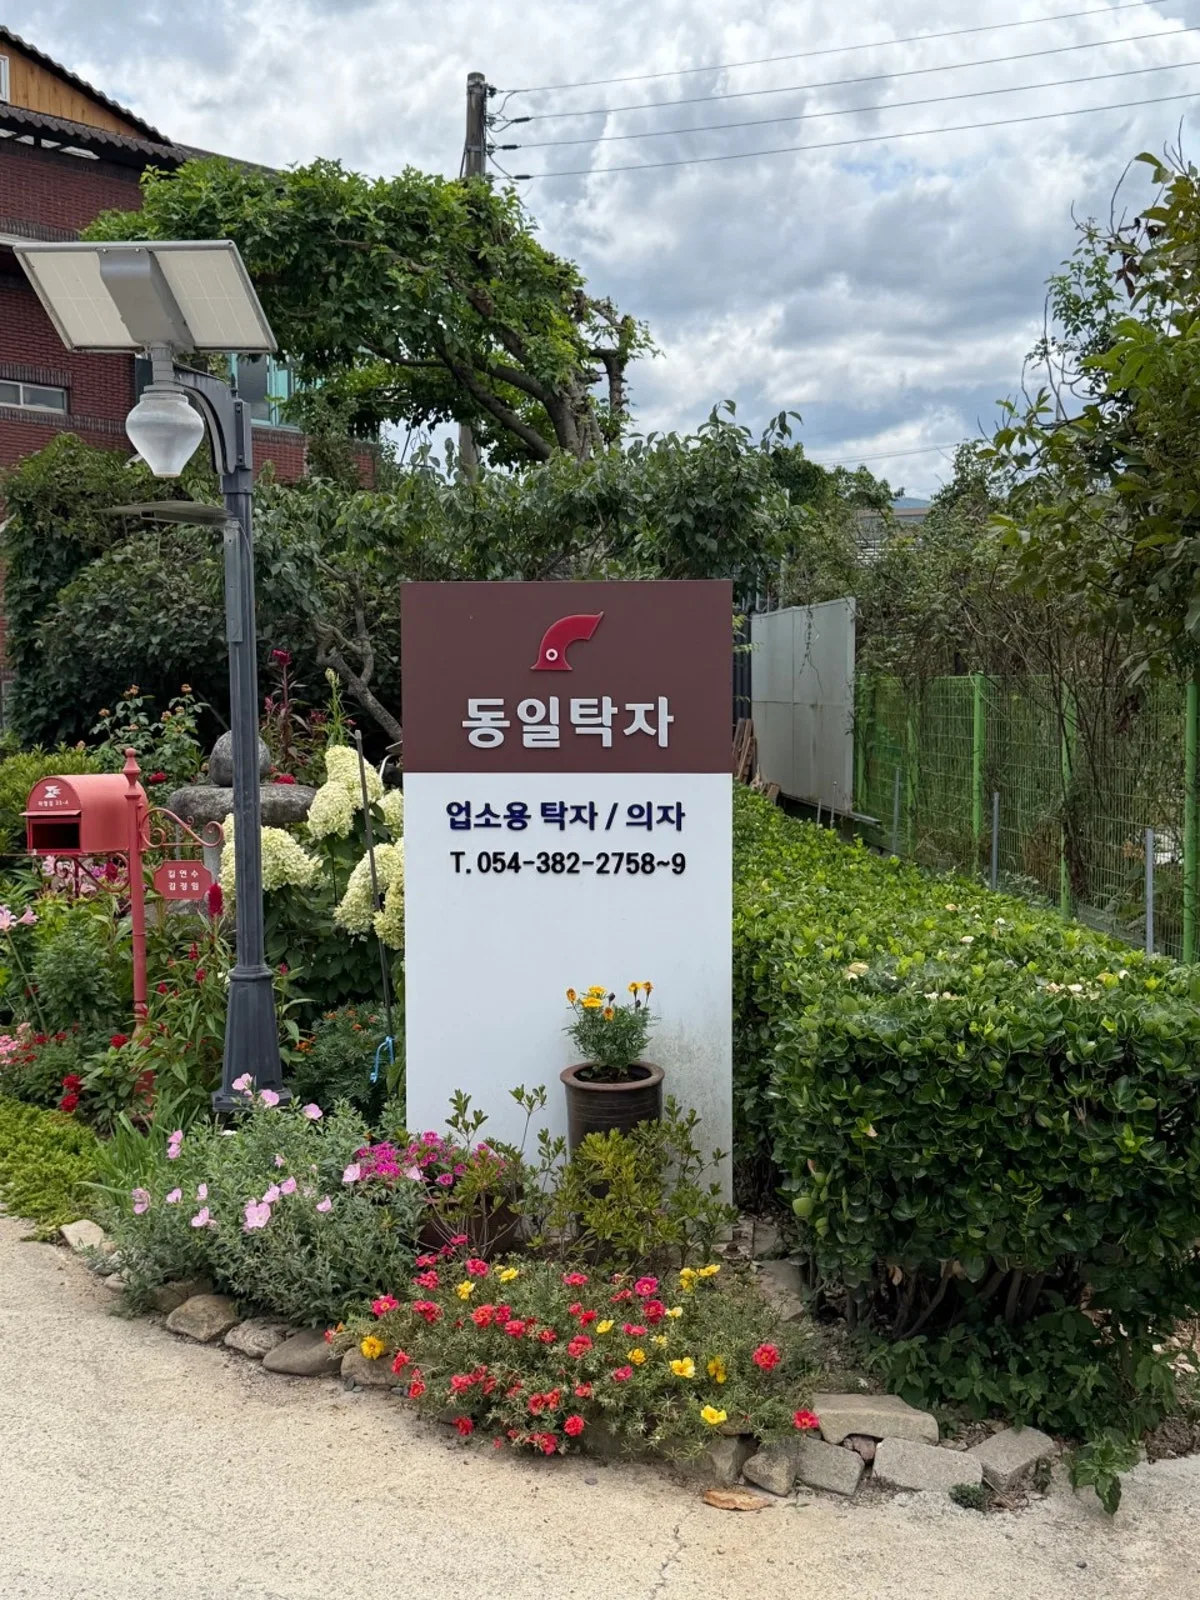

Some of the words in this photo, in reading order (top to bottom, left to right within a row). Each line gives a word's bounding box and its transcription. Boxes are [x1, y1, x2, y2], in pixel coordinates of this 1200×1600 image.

[461, 695, 675, 749] 동일탁자
[446, 800, 532, 831] 업소용
[540, 800, 599, 831] 탁자
[625, 801, 686, 832] 의자
